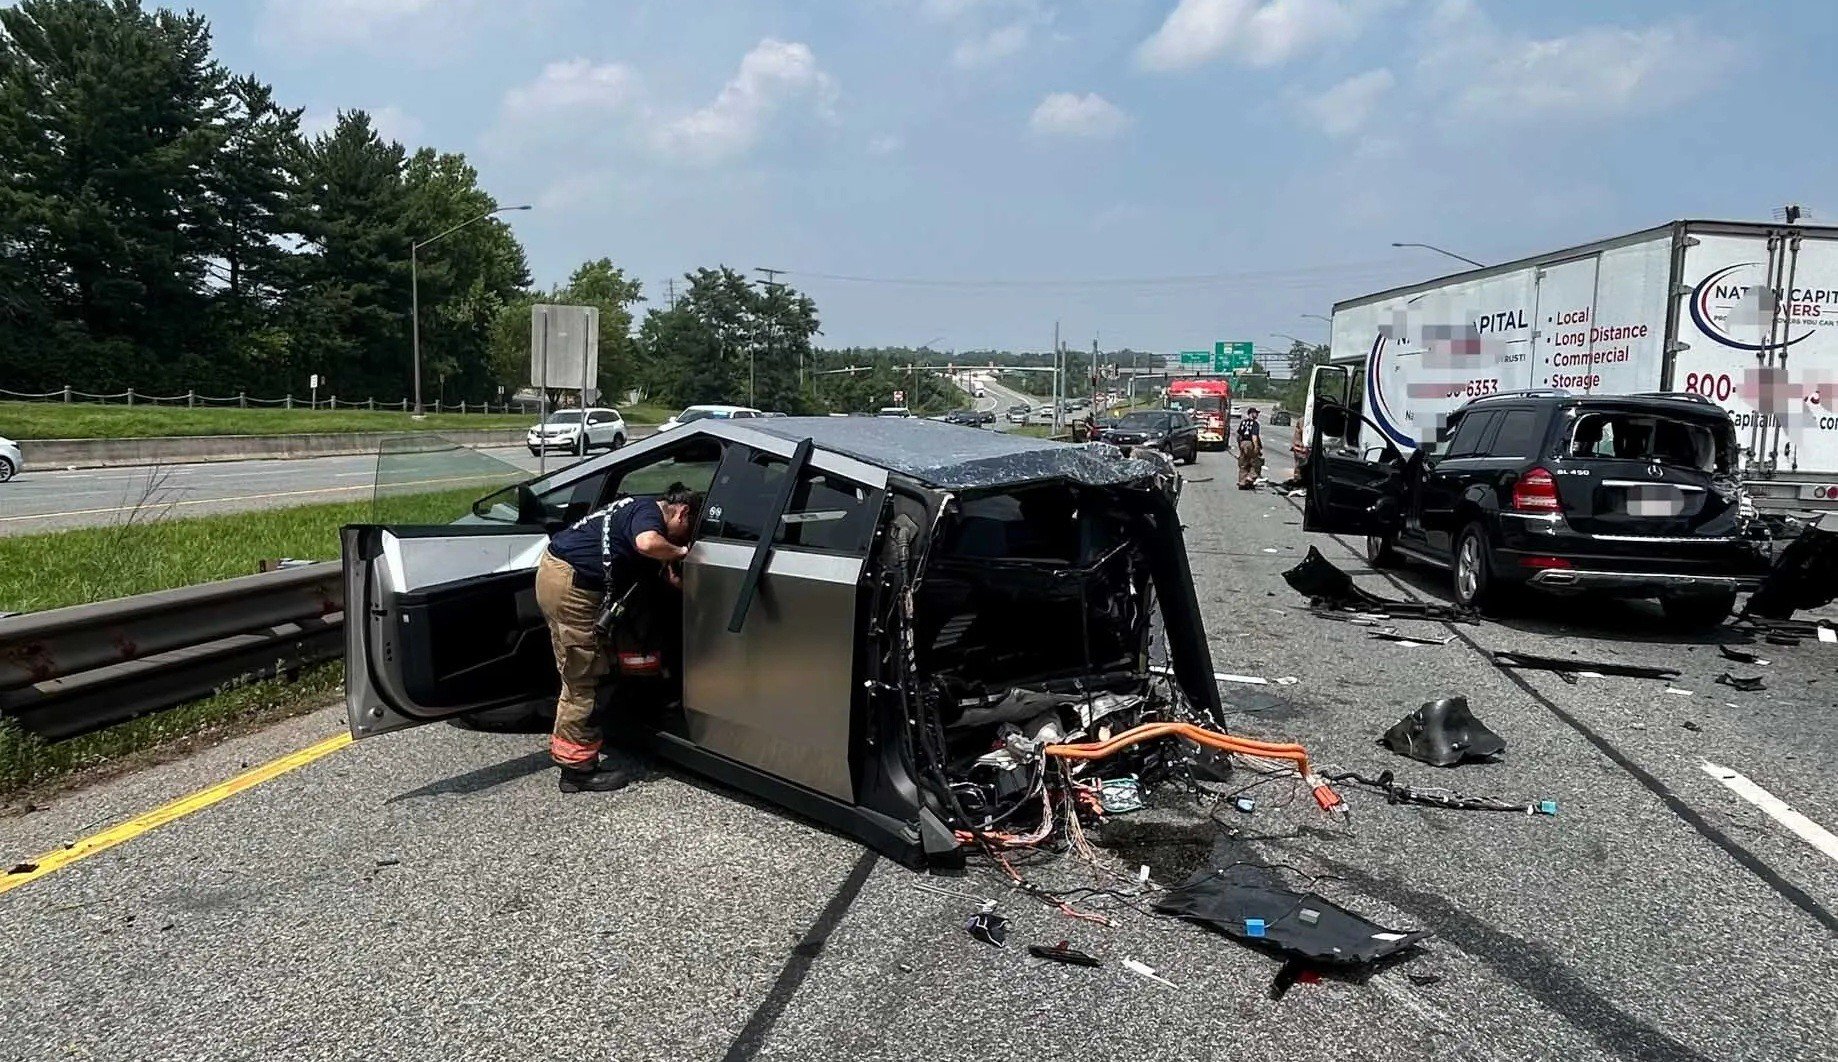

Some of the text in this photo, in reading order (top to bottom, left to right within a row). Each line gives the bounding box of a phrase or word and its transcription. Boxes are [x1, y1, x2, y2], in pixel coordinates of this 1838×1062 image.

[1556, 306, 1590, 326] Local
[1774, 303, 1821, 317] OVERS
[1473, 309, 1529, 334] PITAL
[1555, 324, 1648, 347] Long Distance
[1553, 346, 1630, 367] Commercial
[1552, 374, 1600, 390] Storage
